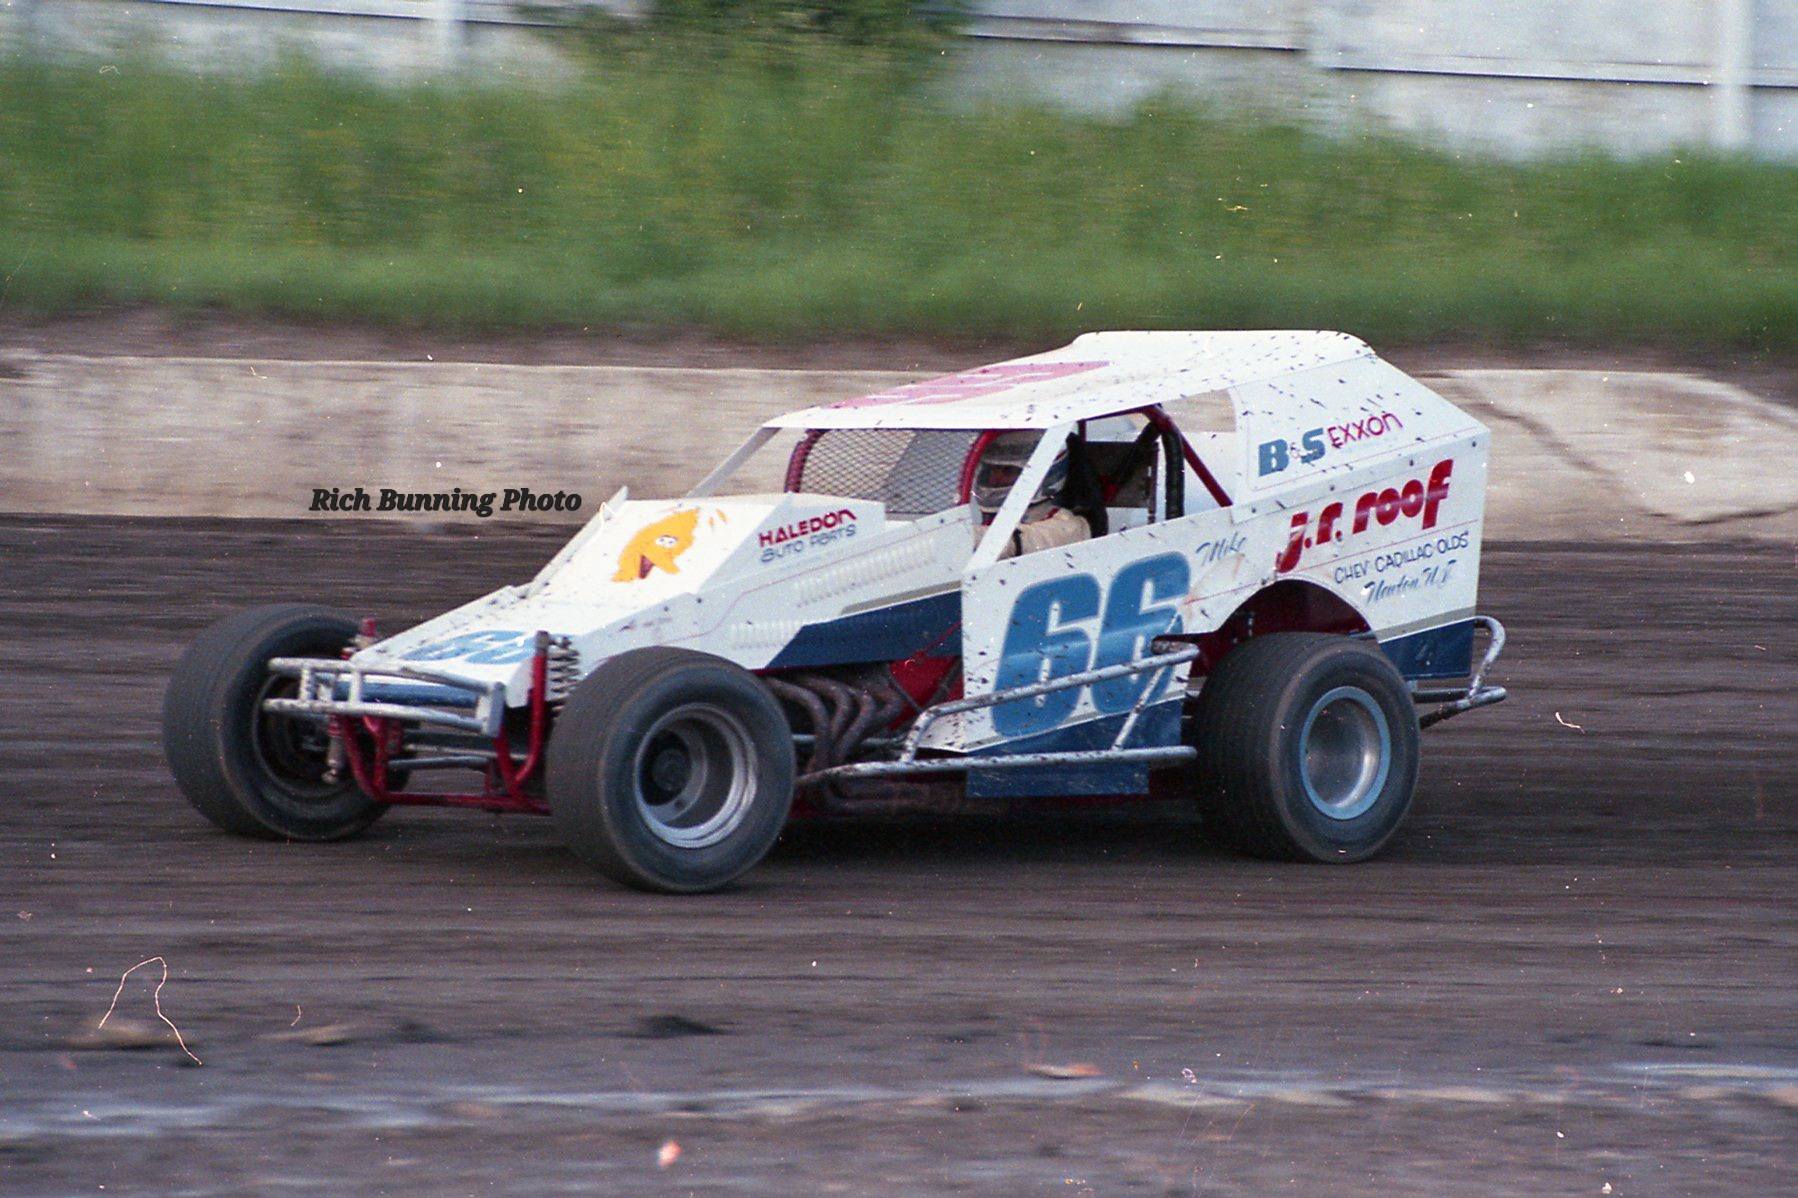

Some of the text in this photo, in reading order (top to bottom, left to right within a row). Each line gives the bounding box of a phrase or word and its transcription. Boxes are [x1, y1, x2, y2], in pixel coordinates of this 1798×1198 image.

[1353, 459, 1454, 534] roof
[1334, 530, 1470, 584] CHEV CADILLAC OLDS
[991, 551, 1190, 737] 66
